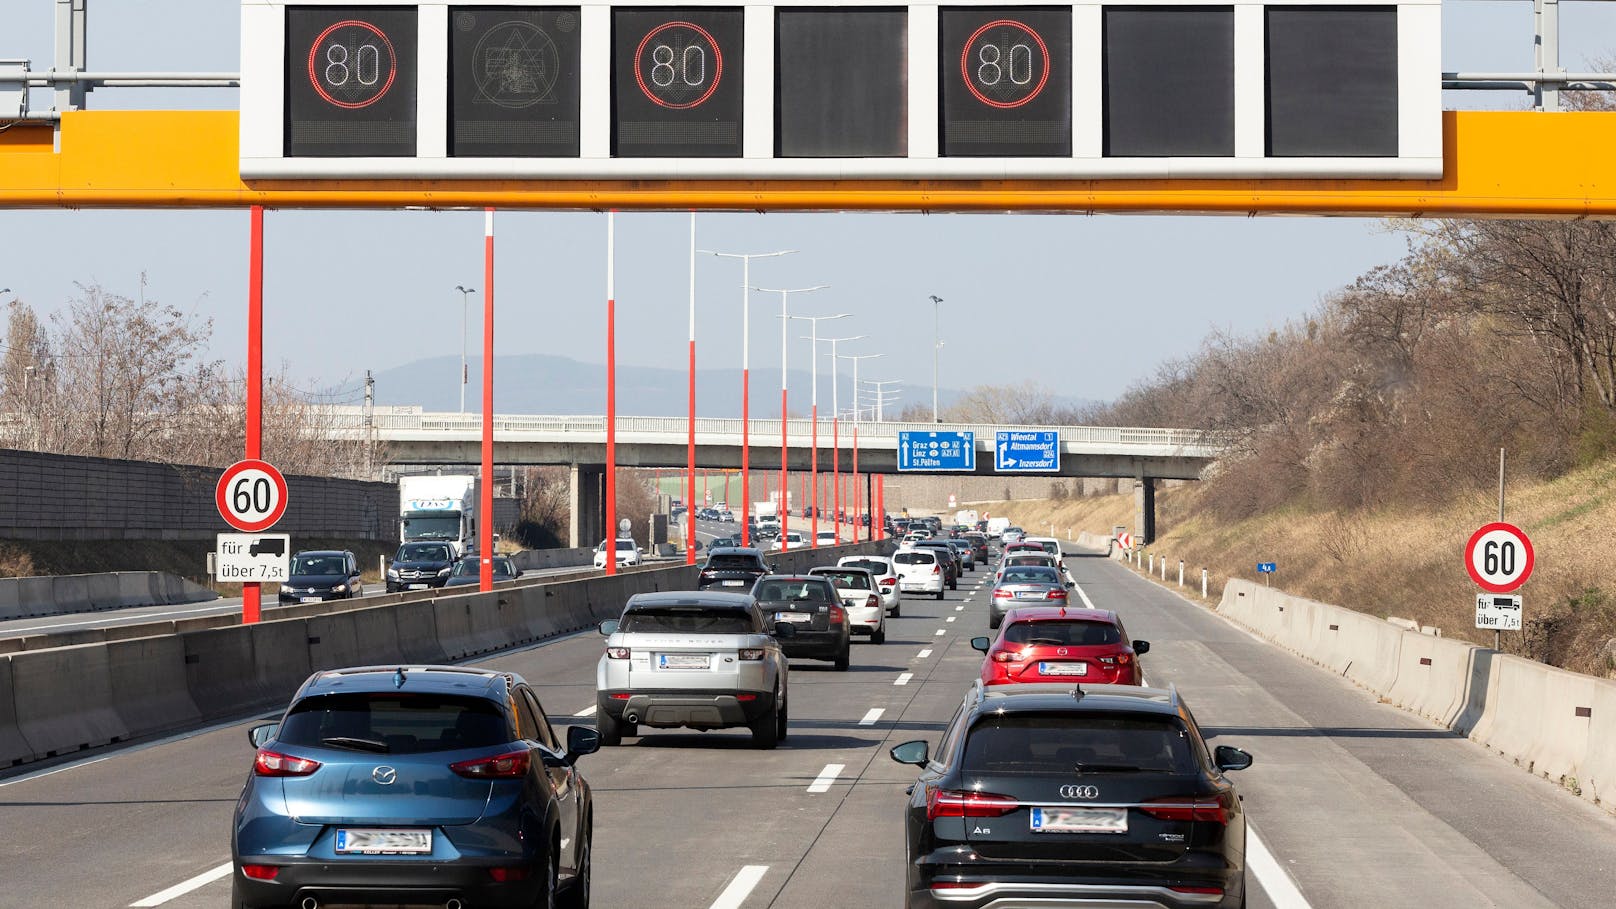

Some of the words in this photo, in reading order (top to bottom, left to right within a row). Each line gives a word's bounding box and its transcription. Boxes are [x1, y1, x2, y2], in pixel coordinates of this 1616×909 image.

[325, 44, 379, 86] 80
[650, 44, 705, 87] 80
[978, 44, 1032, 86] 80
[1010, 433, 1037, 441] Wiental
[912, 441, 928, 449] Graz
[1010, 442, 1054, 451] Altmannsdorf
[912, 449, 926, 457] Linz
[1019, 459, 1054, 468] Inzersdorf
[233, 477, 271, 514] 60
[221, 541, 243, 555] für
[1484, 541, 1515, 575] 60
[222, 564, 254, 578] über
[259, 564, 284, 579] 7,5t
[1477, 613, 1498, 625] über
[973, 826, 991, 835] A6
